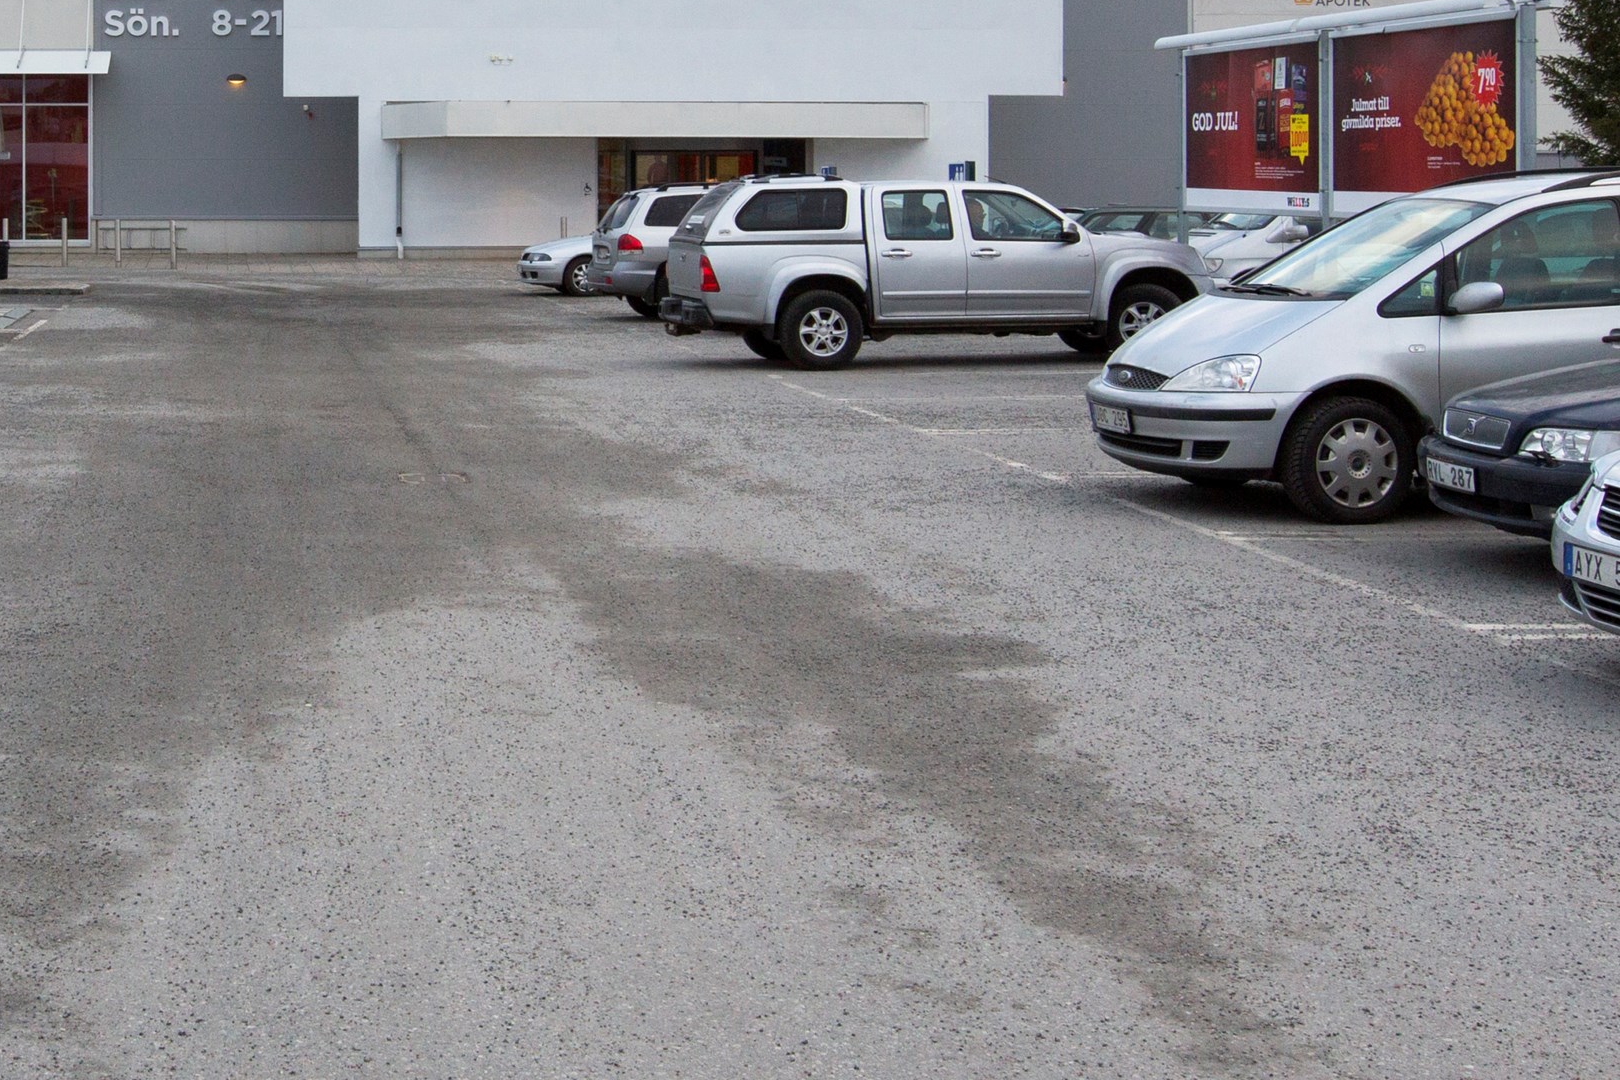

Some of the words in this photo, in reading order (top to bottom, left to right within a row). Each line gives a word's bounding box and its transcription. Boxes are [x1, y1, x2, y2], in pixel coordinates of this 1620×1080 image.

[104, 8, 179, 36] Sön.
[211, 9, 283, 36] 8-21
[1351, 98, 1377, 112] Julmat
[1378, 96, 1390, 111] till
[1192, 111, 1213, 131] GOD
[1214, 111, 1238, 131] JUL!
[1341, 115, 1375, 132] givmilda
[1375, 113, 1402, 131] priser.
[1112, 410, 1128, 428] 295
[1428, 461, 1445, 482] RYL
[1450, 467, 1473, 490] 287
[1574, 550, 1603, 581] AYX
